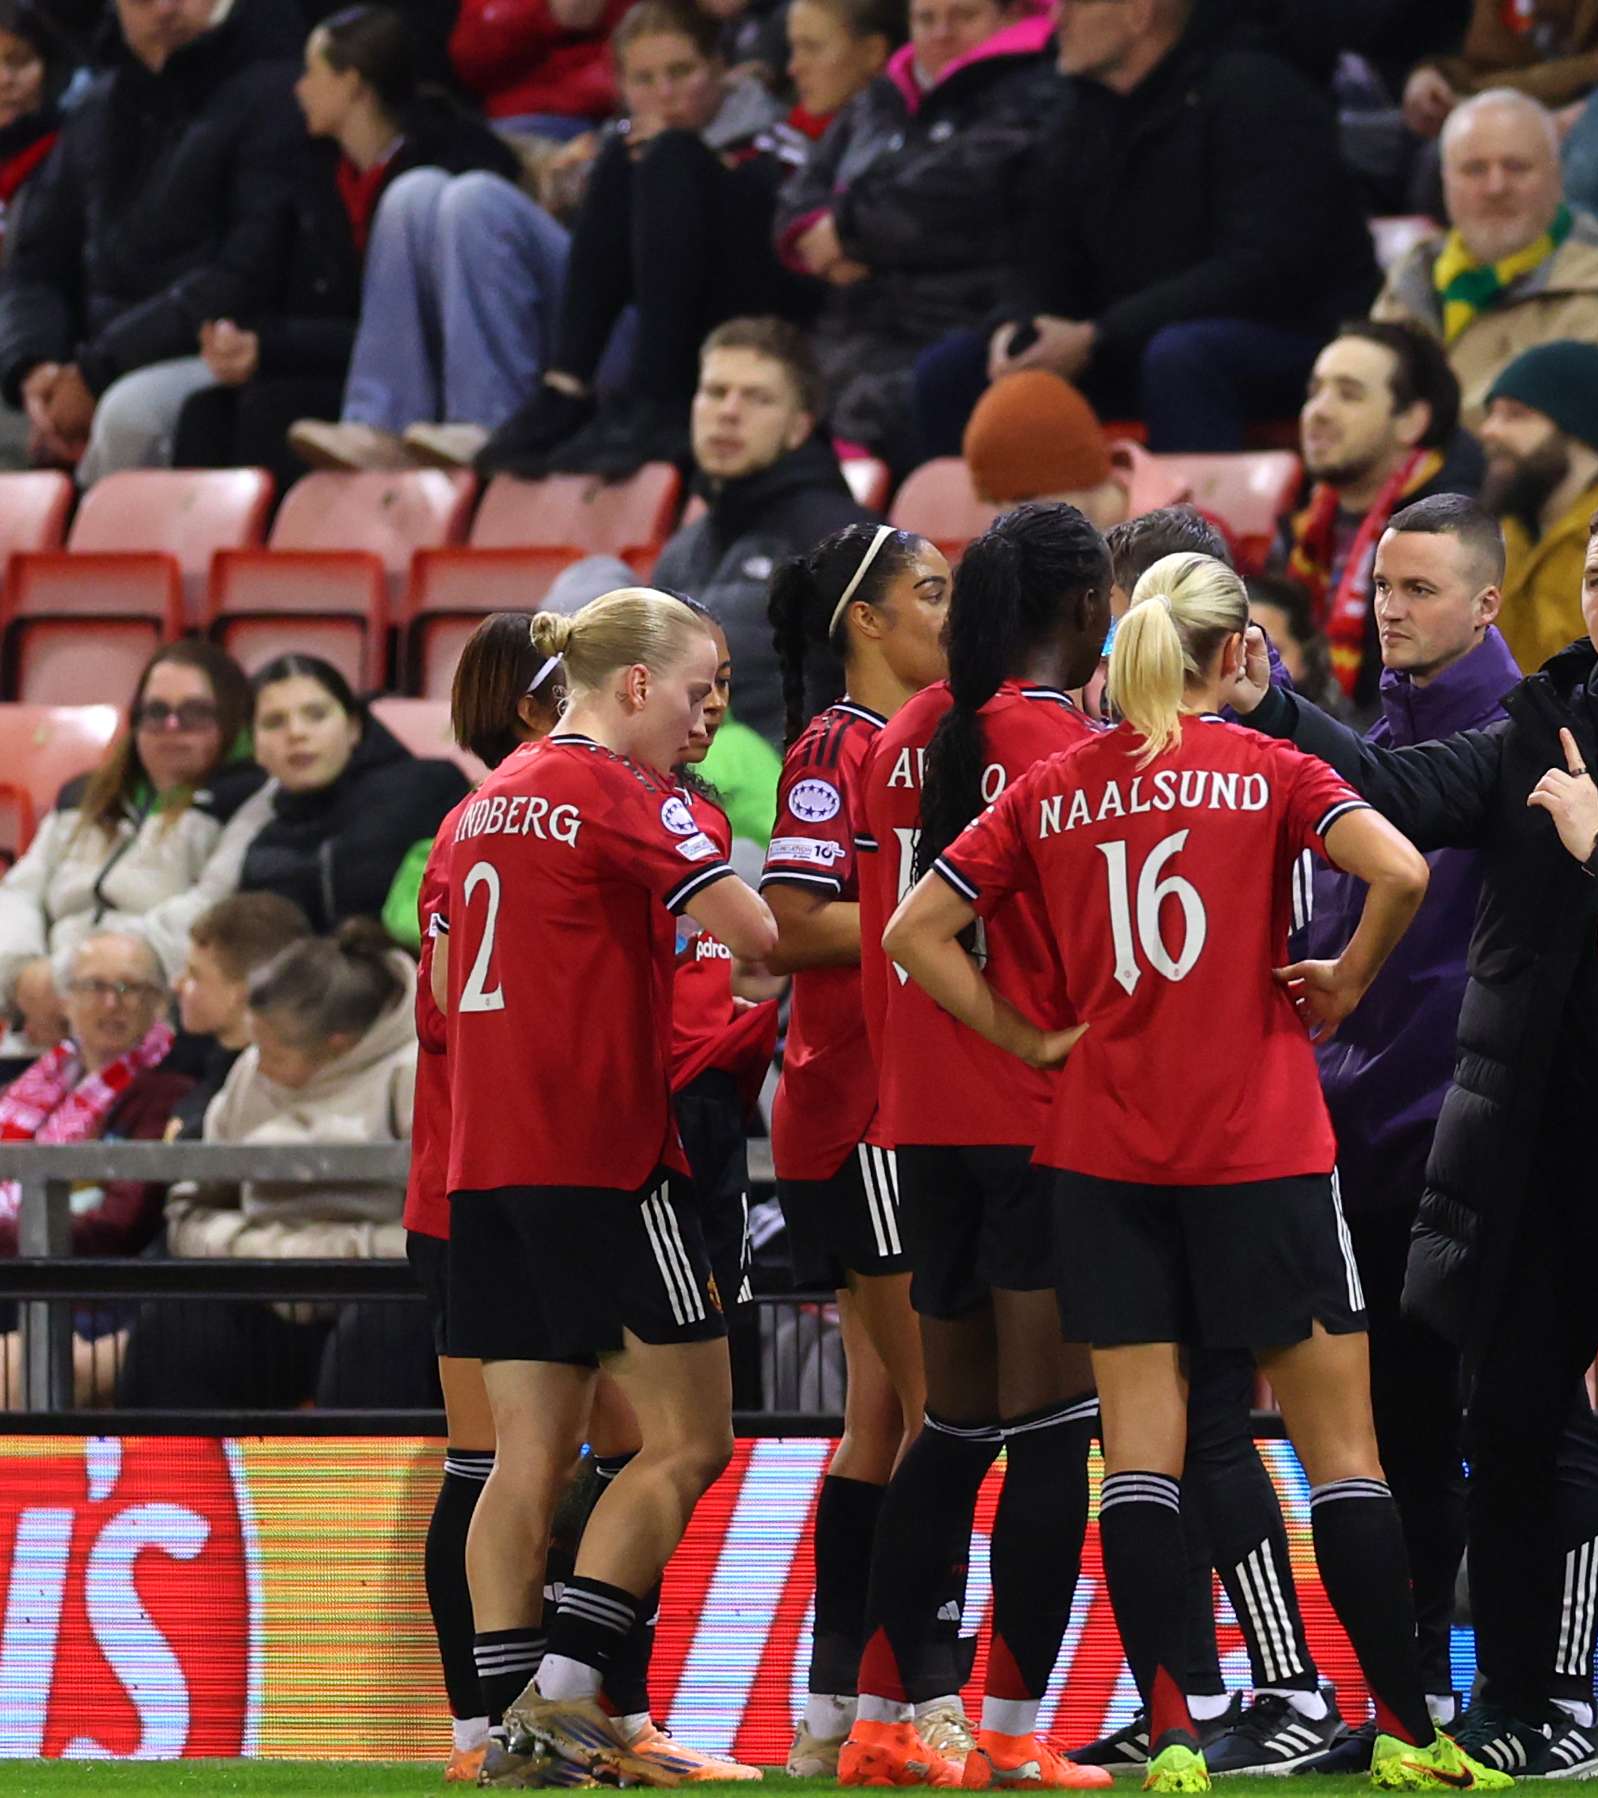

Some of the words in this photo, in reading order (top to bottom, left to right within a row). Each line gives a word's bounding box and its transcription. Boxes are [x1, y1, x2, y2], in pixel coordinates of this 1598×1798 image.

[1039, 770, 1269, 839] NAALSUND
[458, 860, 506, 1013] 2
[1095, 828, 1207, 997] 16
